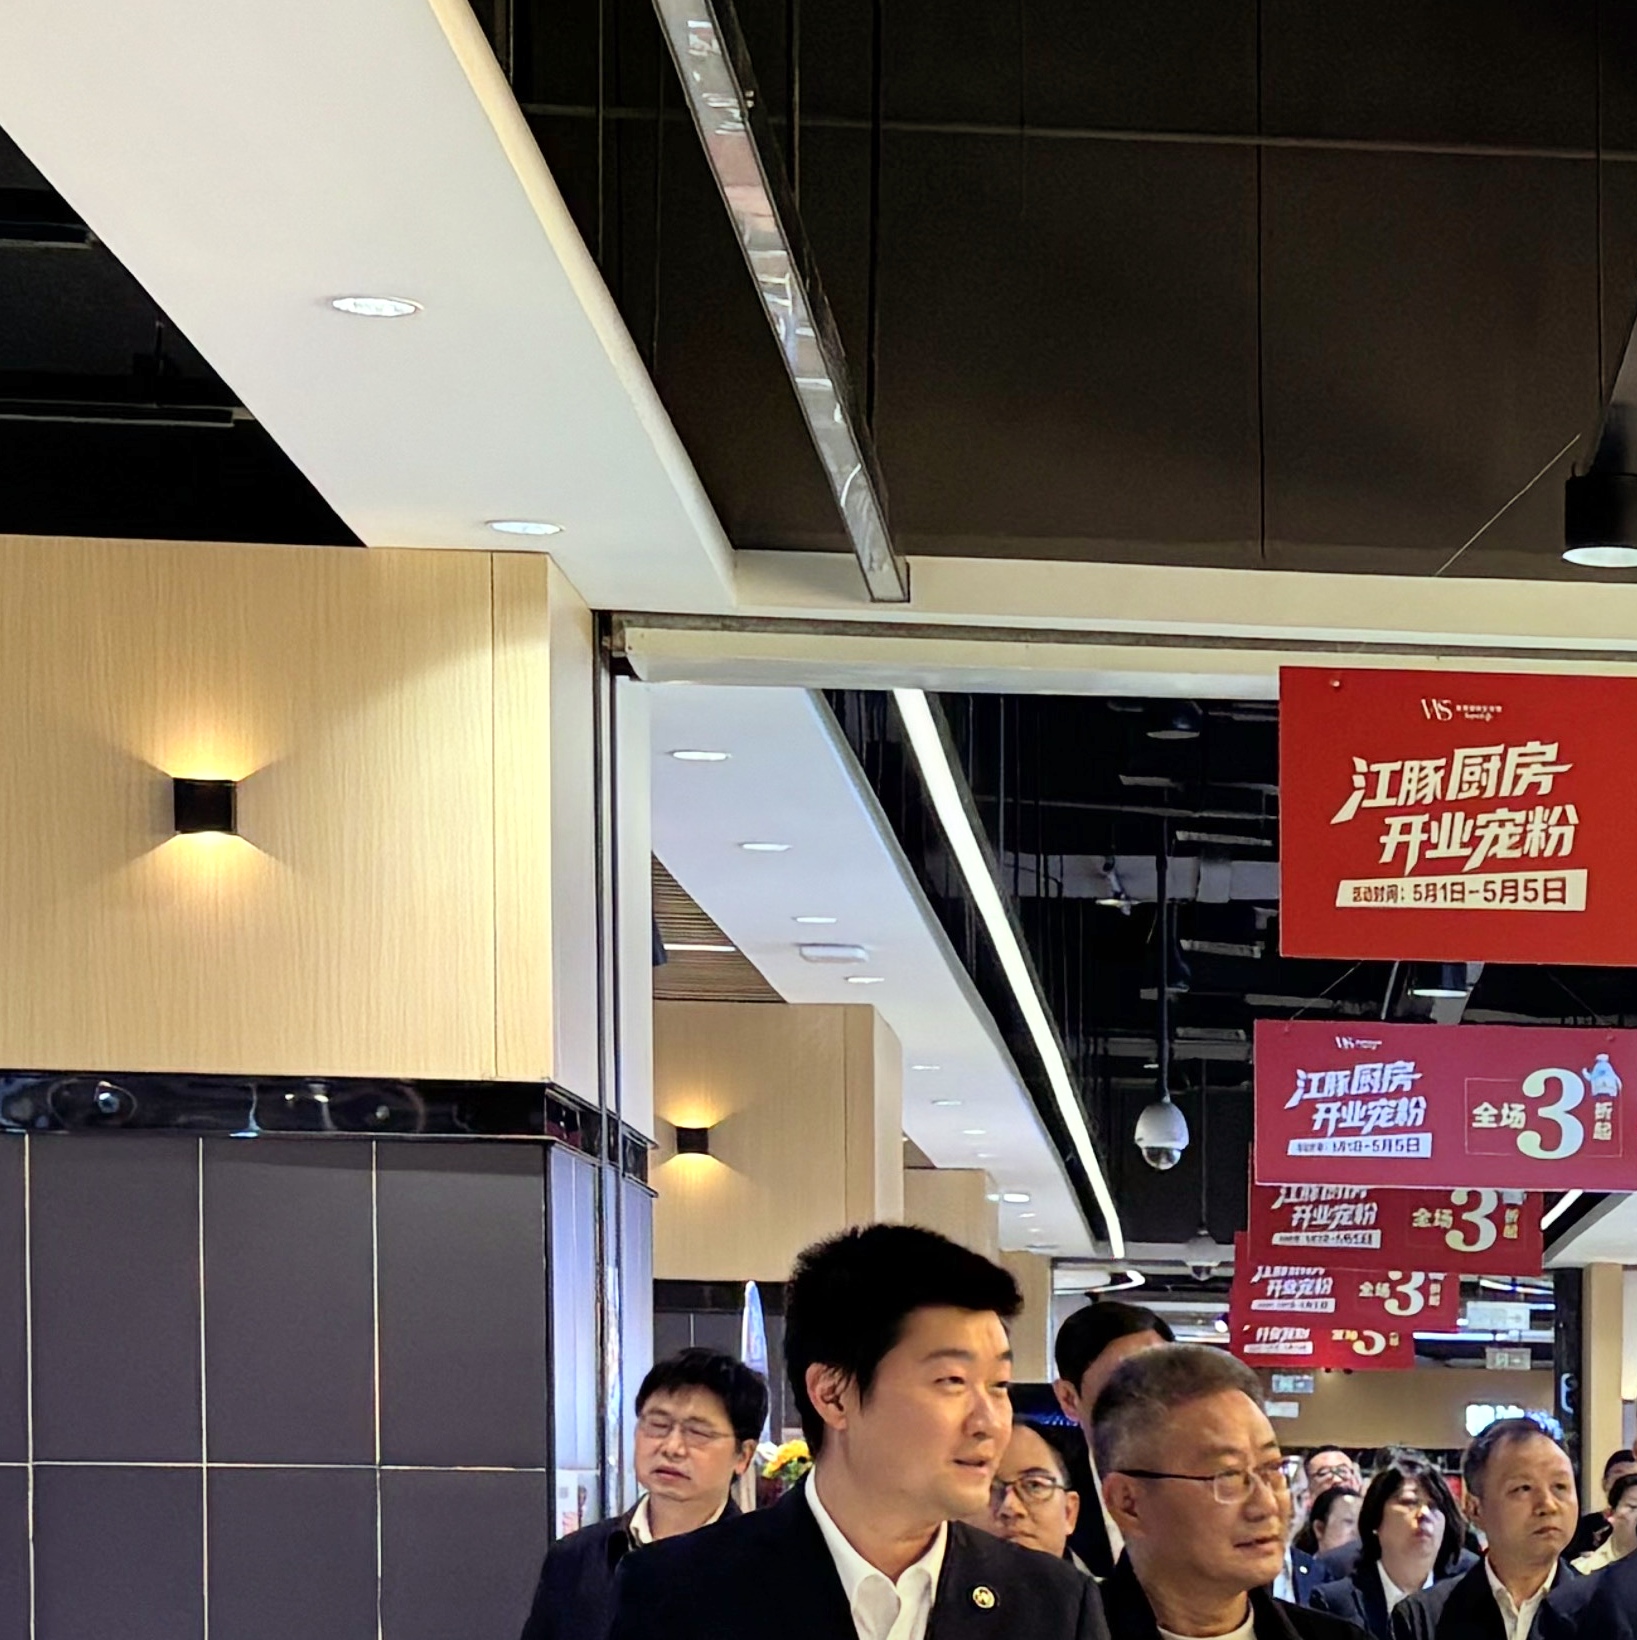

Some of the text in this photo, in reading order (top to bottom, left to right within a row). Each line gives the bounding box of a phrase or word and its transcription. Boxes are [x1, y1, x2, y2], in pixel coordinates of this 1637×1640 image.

[1330, 741, 1573, 824] 江豚厨房
[1379, 804, 1579, 876] 开业宠粉
[1284, 1060, 1422, 1109] 江豚厨房
[1312, 1096, 1427, 1137] 开业宠粉
[1471, 1102, 1527, 1131] 全场
[1516, 1067, 1585, 1160] 3
